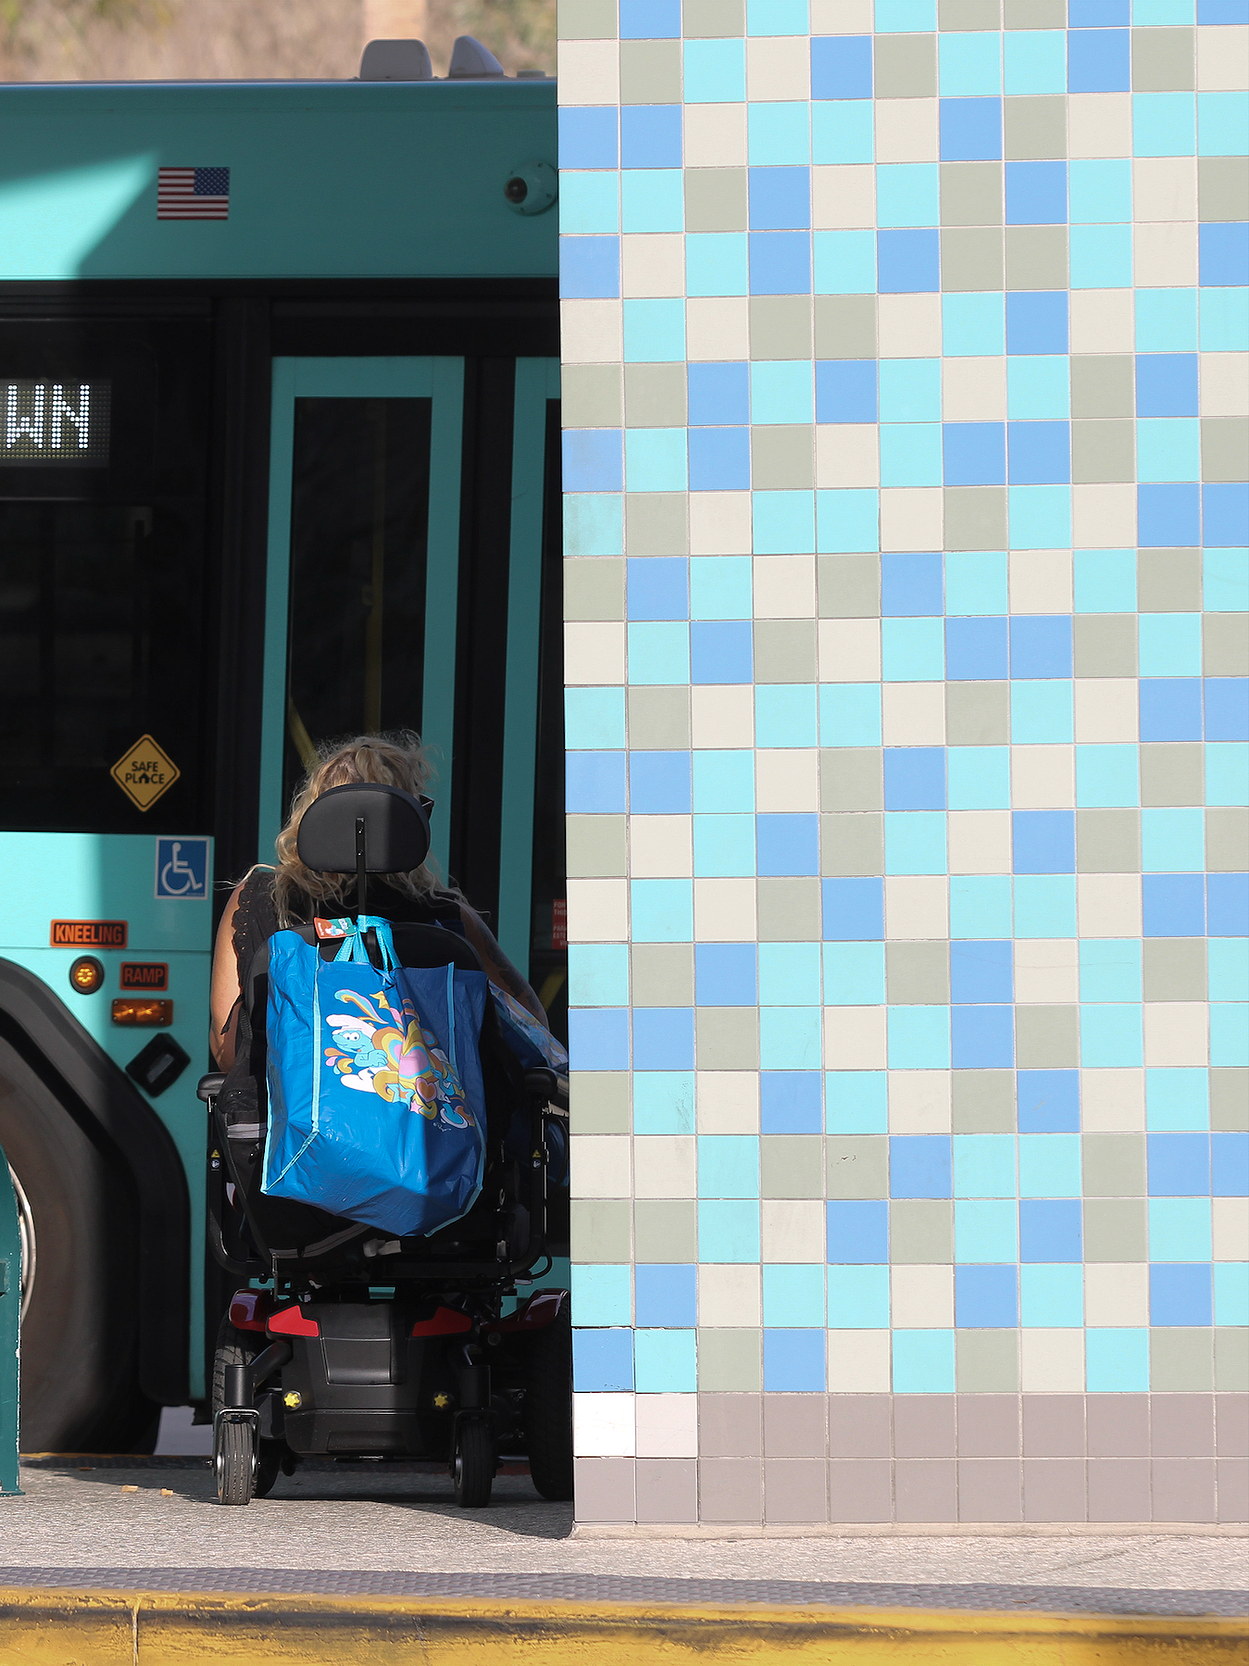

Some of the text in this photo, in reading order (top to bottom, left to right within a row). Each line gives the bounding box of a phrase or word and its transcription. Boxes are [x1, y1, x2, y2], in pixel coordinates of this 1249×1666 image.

[131, 761, 159, 772] SAFE
[125, 772, 165, 784] PLACE
[55, 924, 122, 943] KNEELING
[124, 967, 164, 983] RAMP
